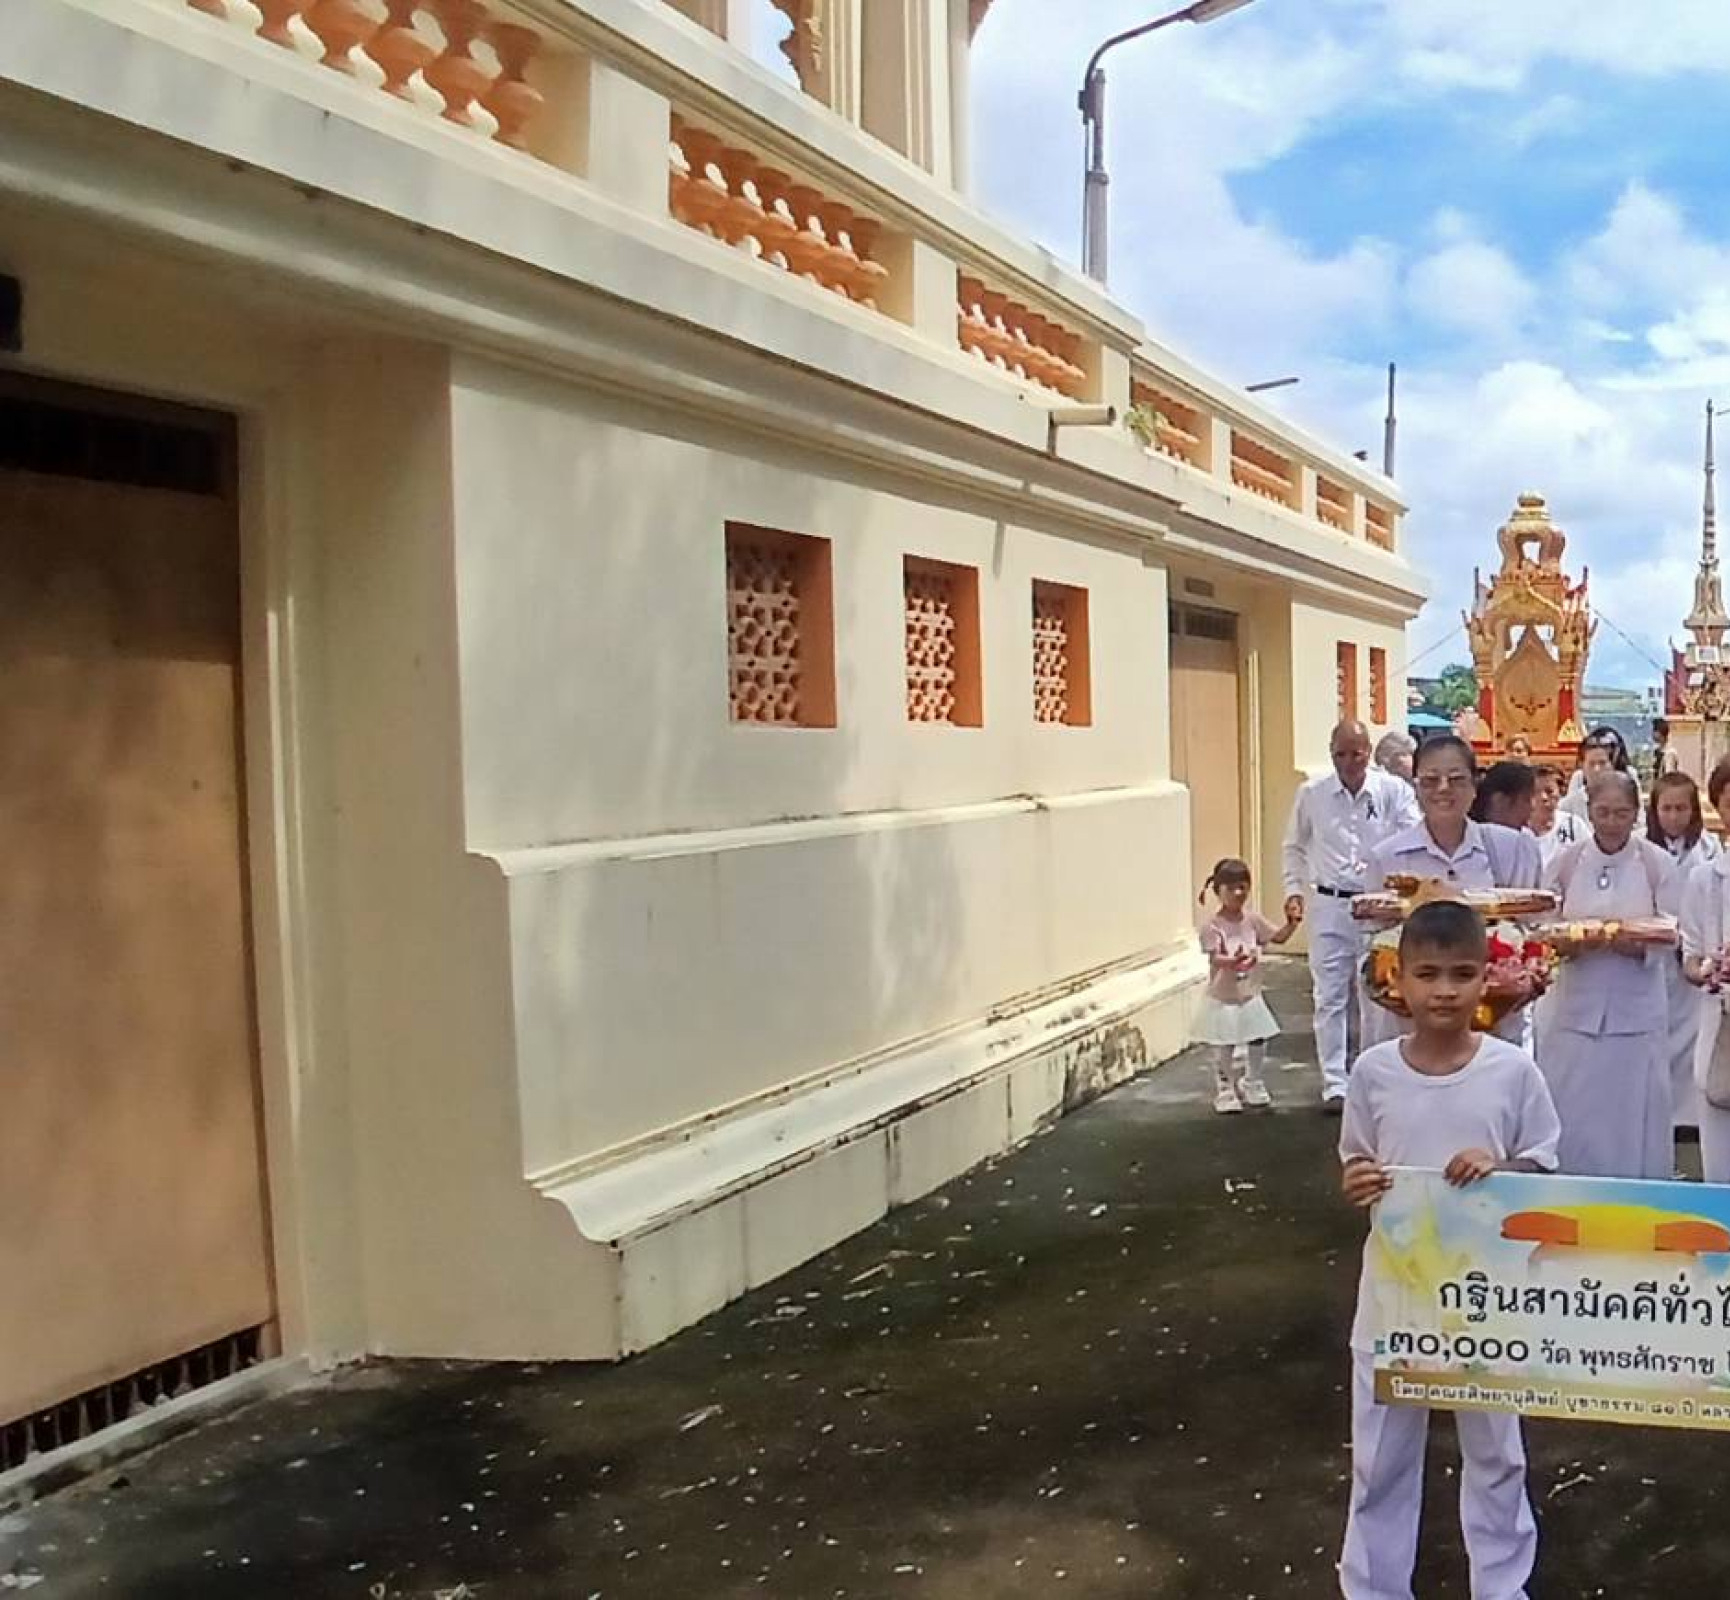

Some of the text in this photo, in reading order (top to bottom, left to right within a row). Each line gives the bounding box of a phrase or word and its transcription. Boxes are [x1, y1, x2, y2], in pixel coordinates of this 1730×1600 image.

[1389, 1331, 1529, 1362] ๓๐,๐๐๐
[1541, 1337, 1572, 1364] วัด
[1579, 1344, 1716, 1376] พุทธศักราช
